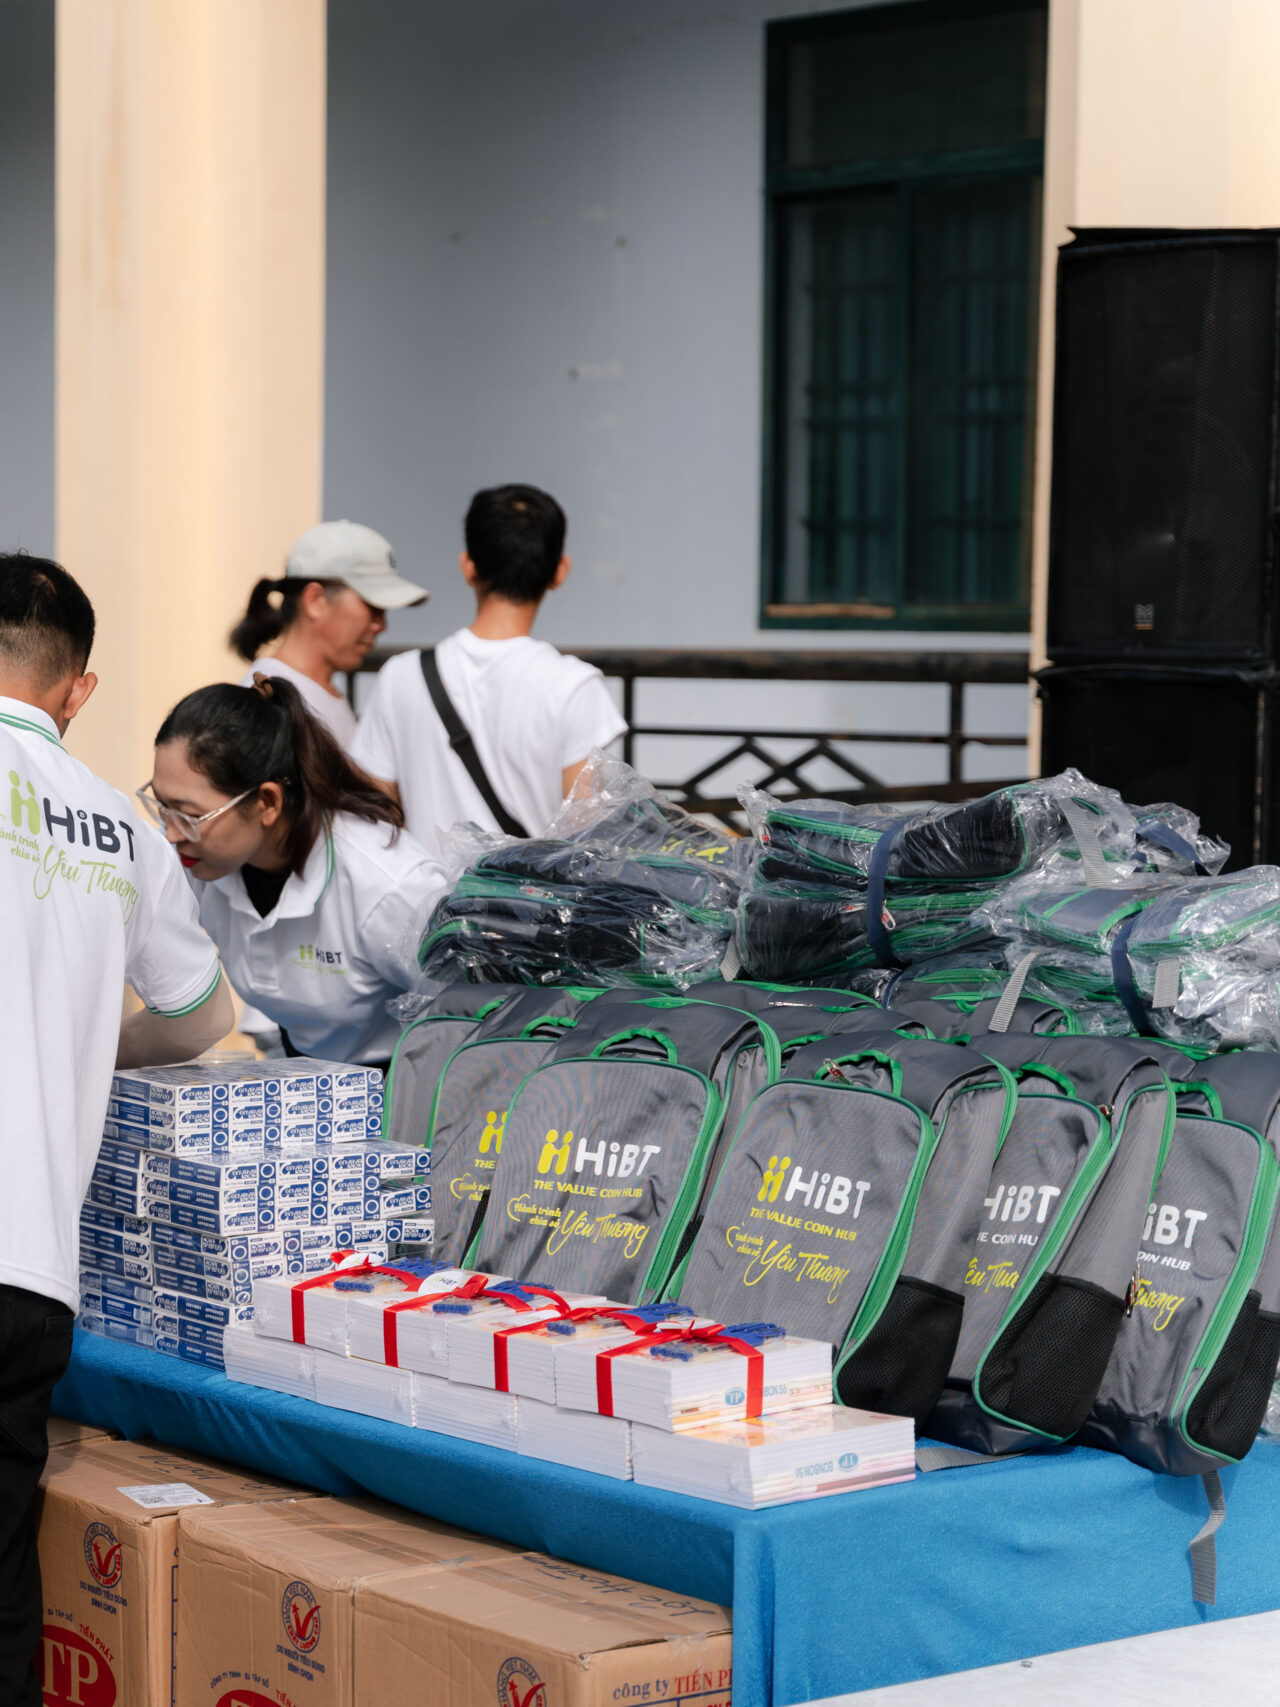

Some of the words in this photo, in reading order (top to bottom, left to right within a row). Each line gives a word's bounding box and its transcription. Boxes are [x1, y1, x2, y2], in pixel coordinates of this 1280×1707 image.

[42, 797, 135, 862] HiBT
[474, 1159, 497, 1169] THE
[574, 1137, 661, 1177] HiBT
[534, 1179, 554, 1191] THE
[557, 1181, 597, 1197] VALUE
[600, 1188, 622, 1199] COIN
[622, 1188, 643, 1199] HUB
[785, 1166, 871, 1219] HiBT
[766, 1209, 803, 1228] VALUE
[804, 1221, 834, 1237] COIN
[835, 1228, 857, 1241] HUB
[1018, 1233, 1039, 1246] HU
[1142, 1203, 1208, 1249] iBT
[1137, 1251, 1160, 1264] OIN
[1160, 1256, 1191, 1271] HUB
[80, 1623, 95, 1642] TIẾN
[613, 1682, 651, 1701] công
[655, 1679, 669, 1697] ty
[674, 1665, 713, 1695] TIẾN
